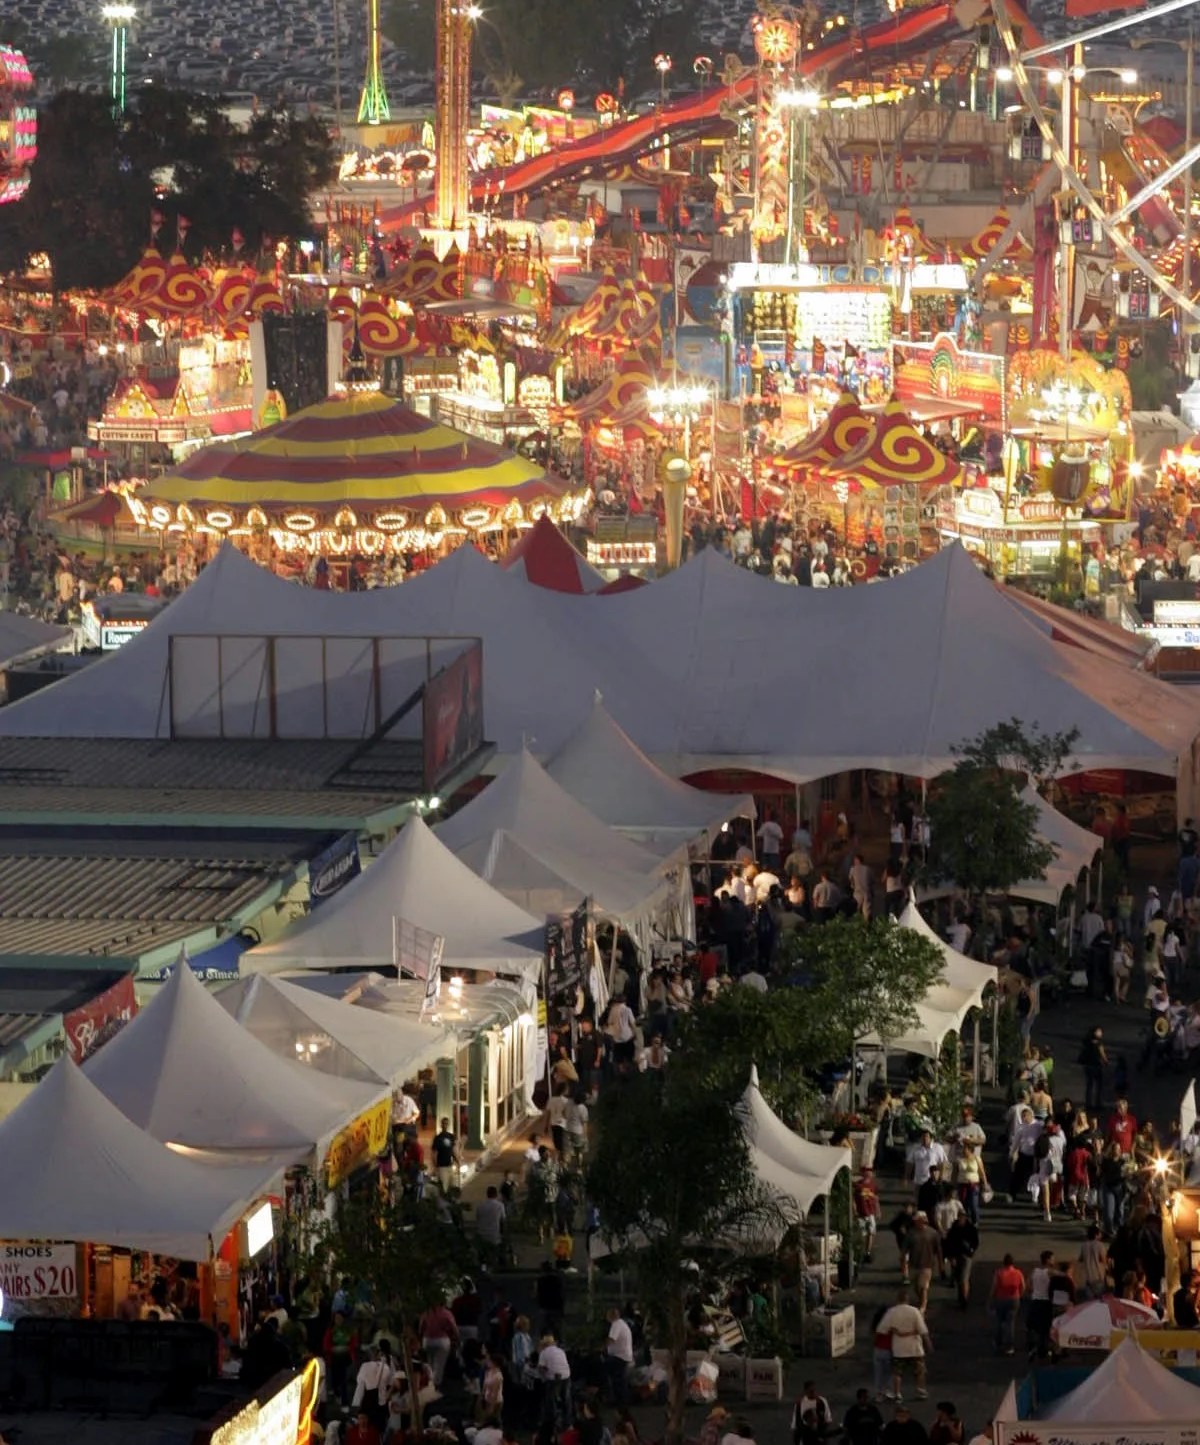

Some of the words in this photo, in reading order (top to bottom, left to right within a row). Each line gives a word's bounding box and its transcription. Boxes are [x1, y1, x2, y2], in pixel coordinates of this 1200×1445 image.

[6, 1246, 53, 1258] SHOES
[0, 1275, 31, 1296] AIRS
[34, 1265, 74, 1296] $20
